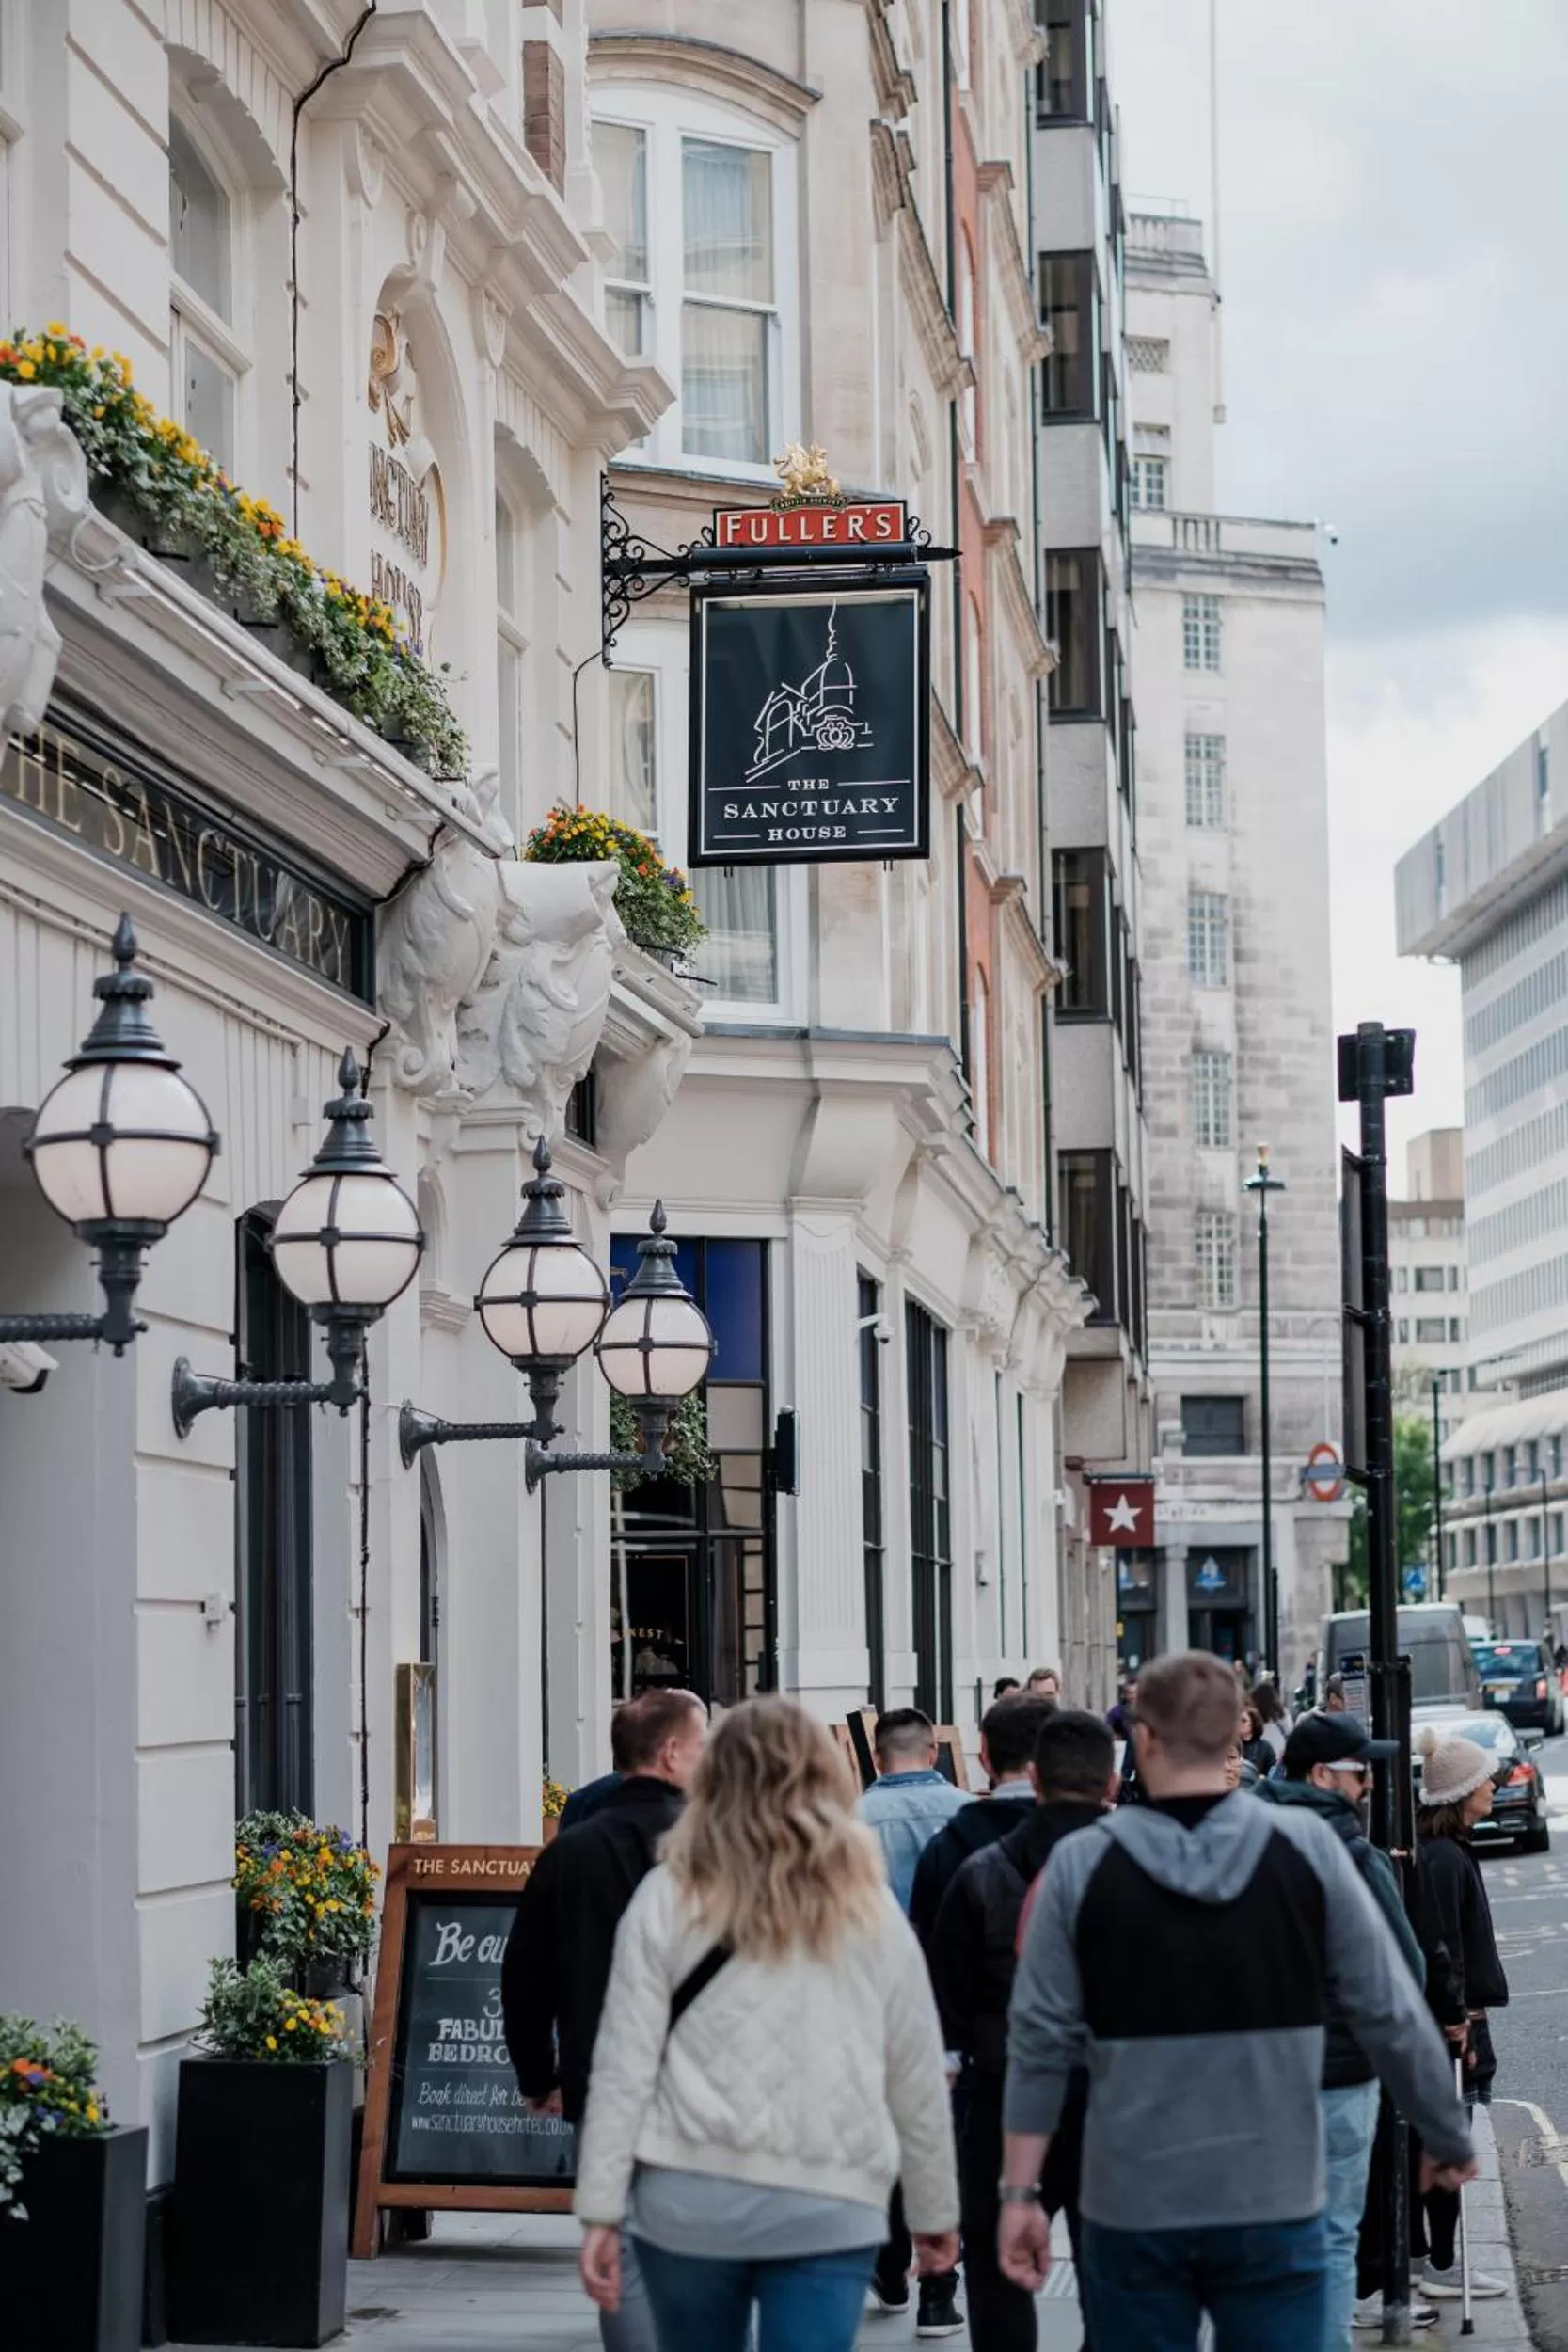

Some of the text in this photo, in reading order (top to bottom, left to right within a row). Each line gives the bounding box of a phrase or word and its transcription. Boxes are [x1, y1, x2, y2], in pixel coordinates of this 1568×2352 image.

[726, 508, 892, 543] FULLER'S
[787, 779, 830, 791] THE
[723, 797, 899, 819] SANCTUARY
[768, 825, 847, 842] HOUSE
[15, 723, 349, 985] HE SANCTUARY
[413, 1858, 531, 1876] THE SANCTUA
[428, 1920, 509, 1966] Be ou
[482, 1987, 504, 2019] 3
[436, 2017, 506, 2041] FABUL
[427, 2042, 511, 2065] BEDRO
[417, 2081, 452, 2106] Book
[511, 2085, 527, 2107] be
